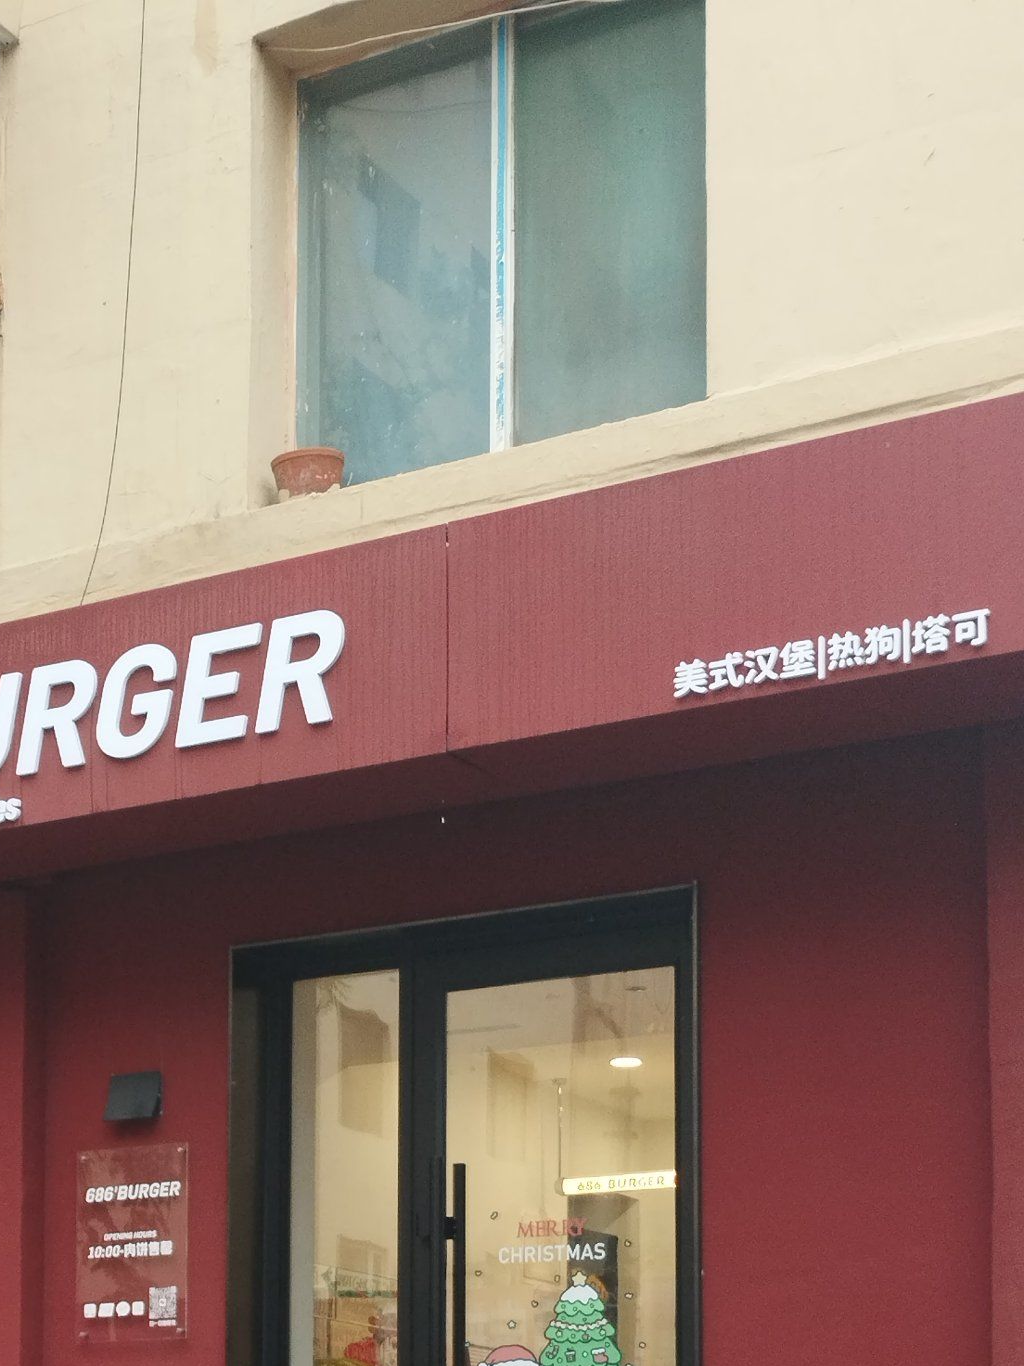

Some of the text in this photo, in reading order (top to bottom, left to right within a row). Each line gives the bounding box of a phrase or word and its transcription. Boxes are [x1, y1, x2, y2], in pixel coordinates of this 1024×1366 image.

[85, 1181, 181, 1203] 686'BURGER
[577, 1176, 664, 1191] 686 BURGER
[517, 1217, 589, 1238] MERRY
[499, 1243, 606, 1264] CHRISTMAS
